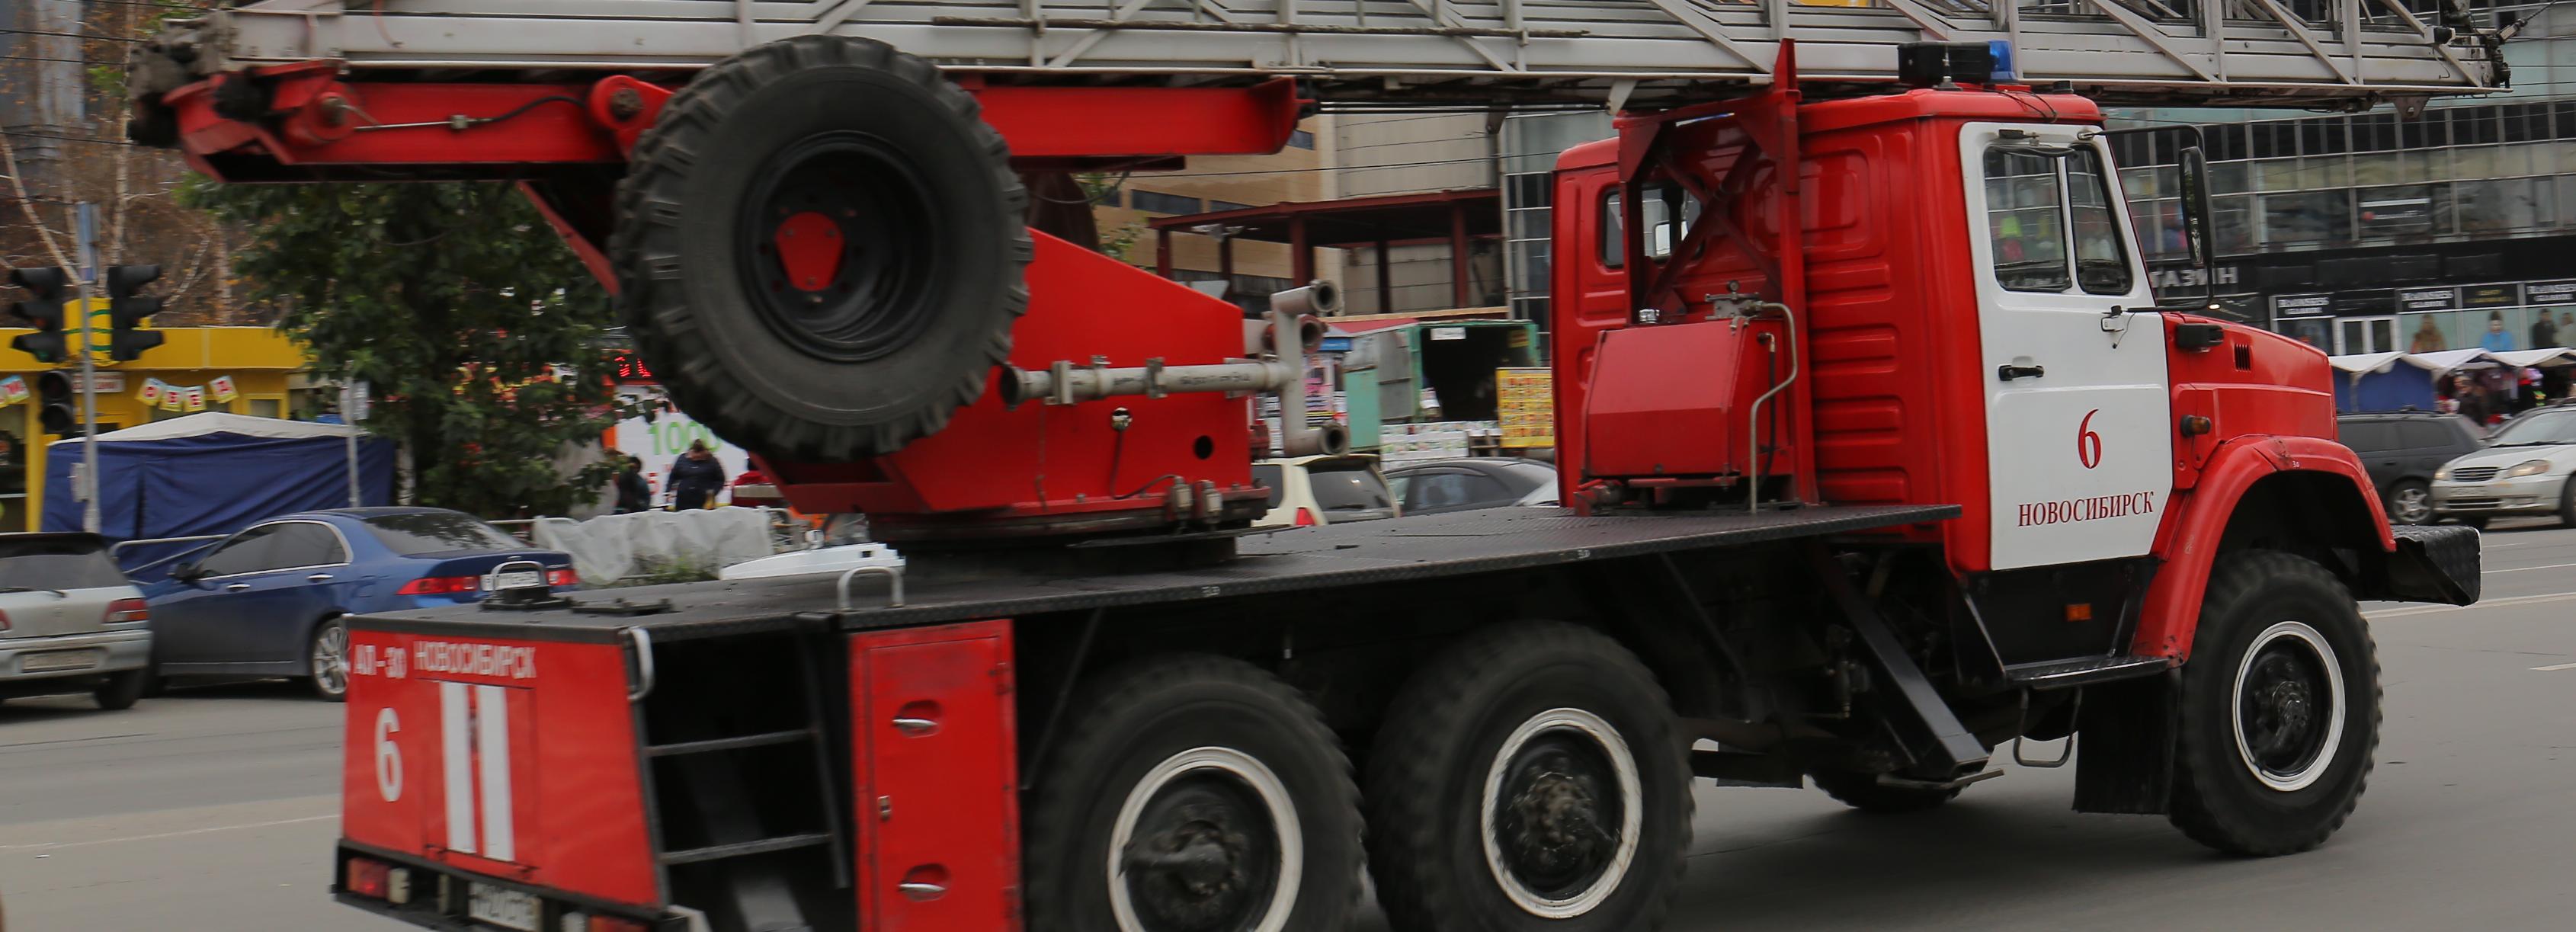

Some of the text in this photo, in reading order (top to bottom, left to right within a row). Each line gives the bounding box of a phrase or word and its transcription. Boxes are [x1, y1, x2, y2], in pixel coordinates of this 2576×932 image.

[2078, 408, 2101, 469] 6
[2018, 492, 2154, 527] НОВОСИБИРСК
[414, 641, 536, 679] НОВОСИБИРСК
[374, 707, 403, 802] 6
